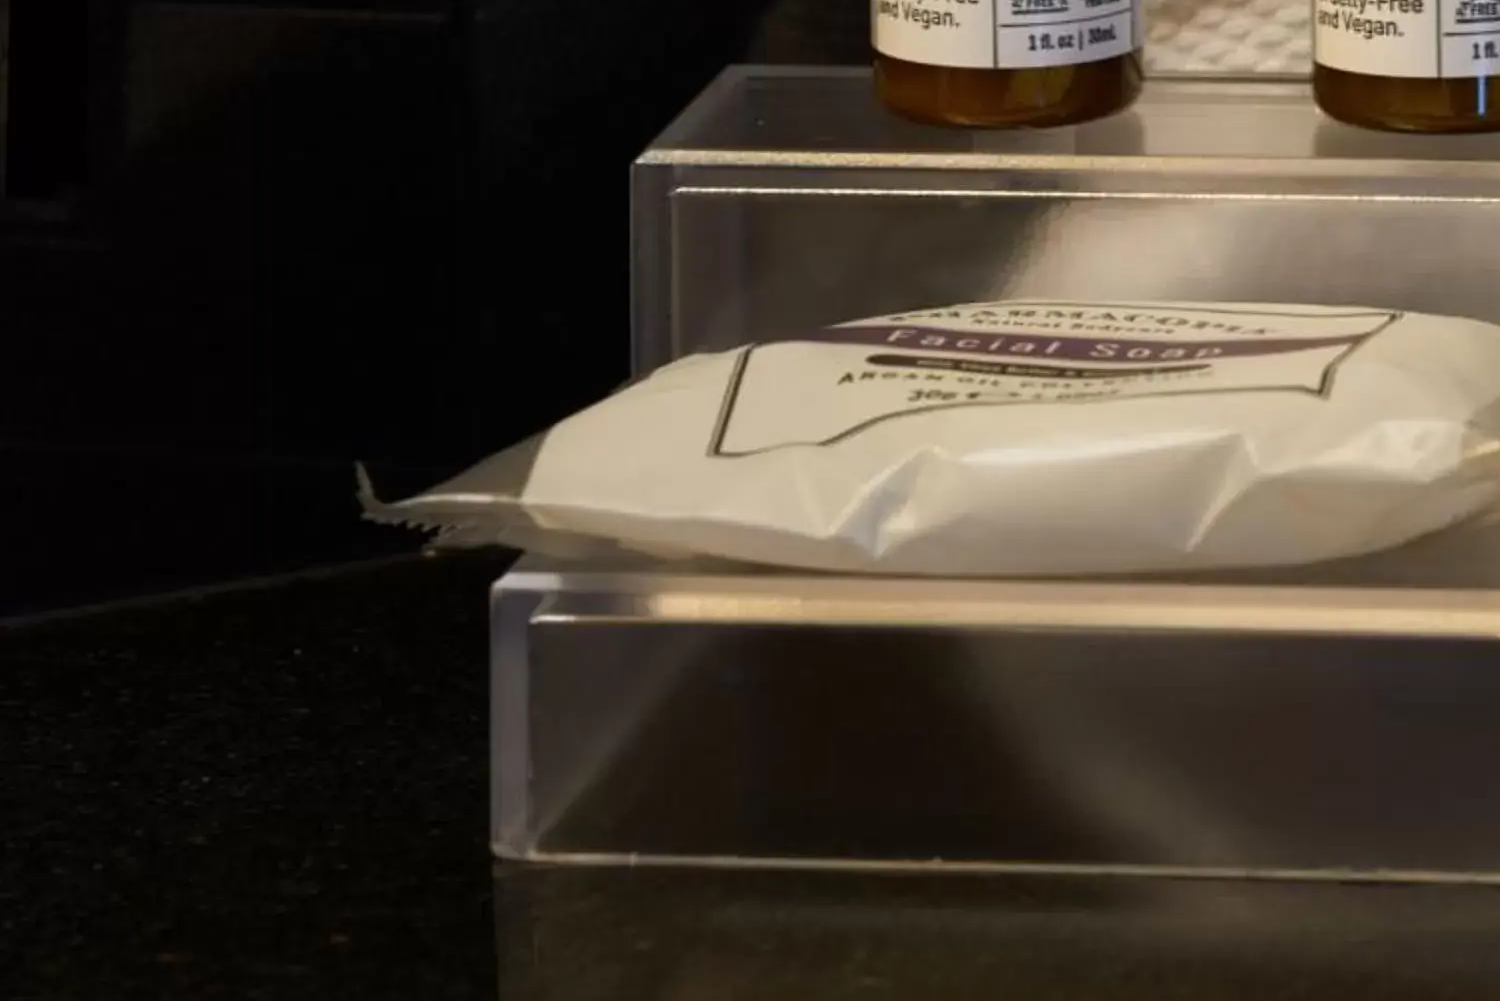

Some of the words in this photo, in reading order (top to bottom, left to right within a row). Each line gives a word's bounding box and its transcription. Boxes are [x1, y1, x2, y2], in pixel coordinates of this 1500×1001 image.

[878, 0, 898, 18] and
[901, 3, 960, 29] Vegan.
[1318, 9, 1339, 28] and
[1343, 13, 1405, 39] Vegan.
[1028, 34, 1036, 51] 1
[1473, 43, 1480, 59] 1
[886, 328, 1061, 355] Facial
[1090, 342, 1224, 360] Soap
